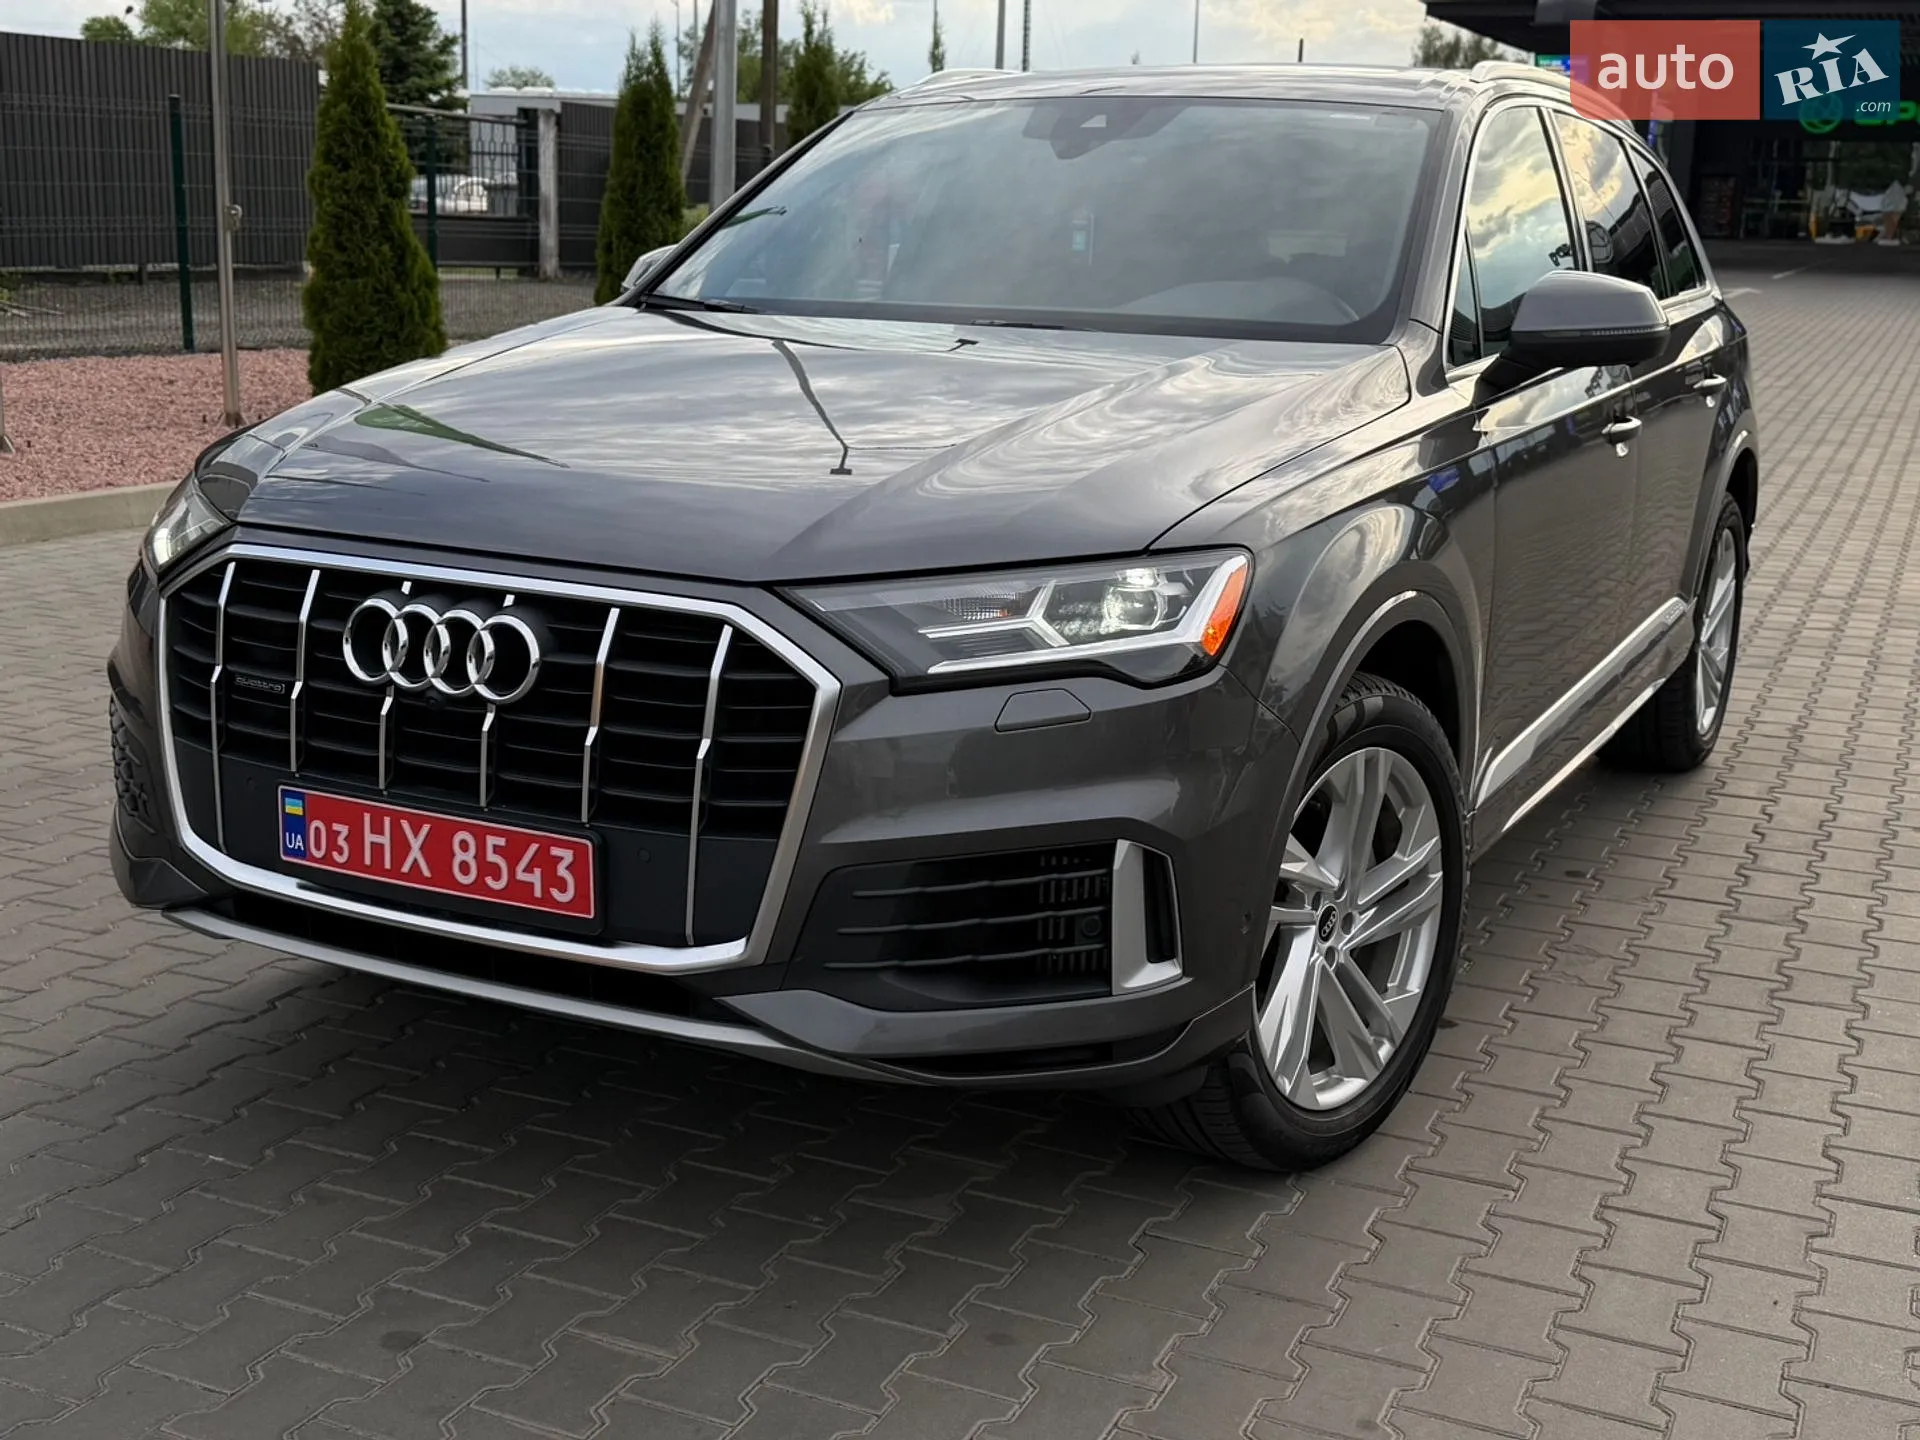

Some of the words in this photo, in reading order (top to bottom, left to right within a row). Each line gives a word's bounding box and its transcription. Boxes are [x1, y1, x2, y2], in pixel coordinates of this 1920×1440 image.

[285, 832, 305, 851] UA
[308, 819, 350, 864] 03
[363, 812, 432, 878] HX
[452, 830, 575, 903] 8543
